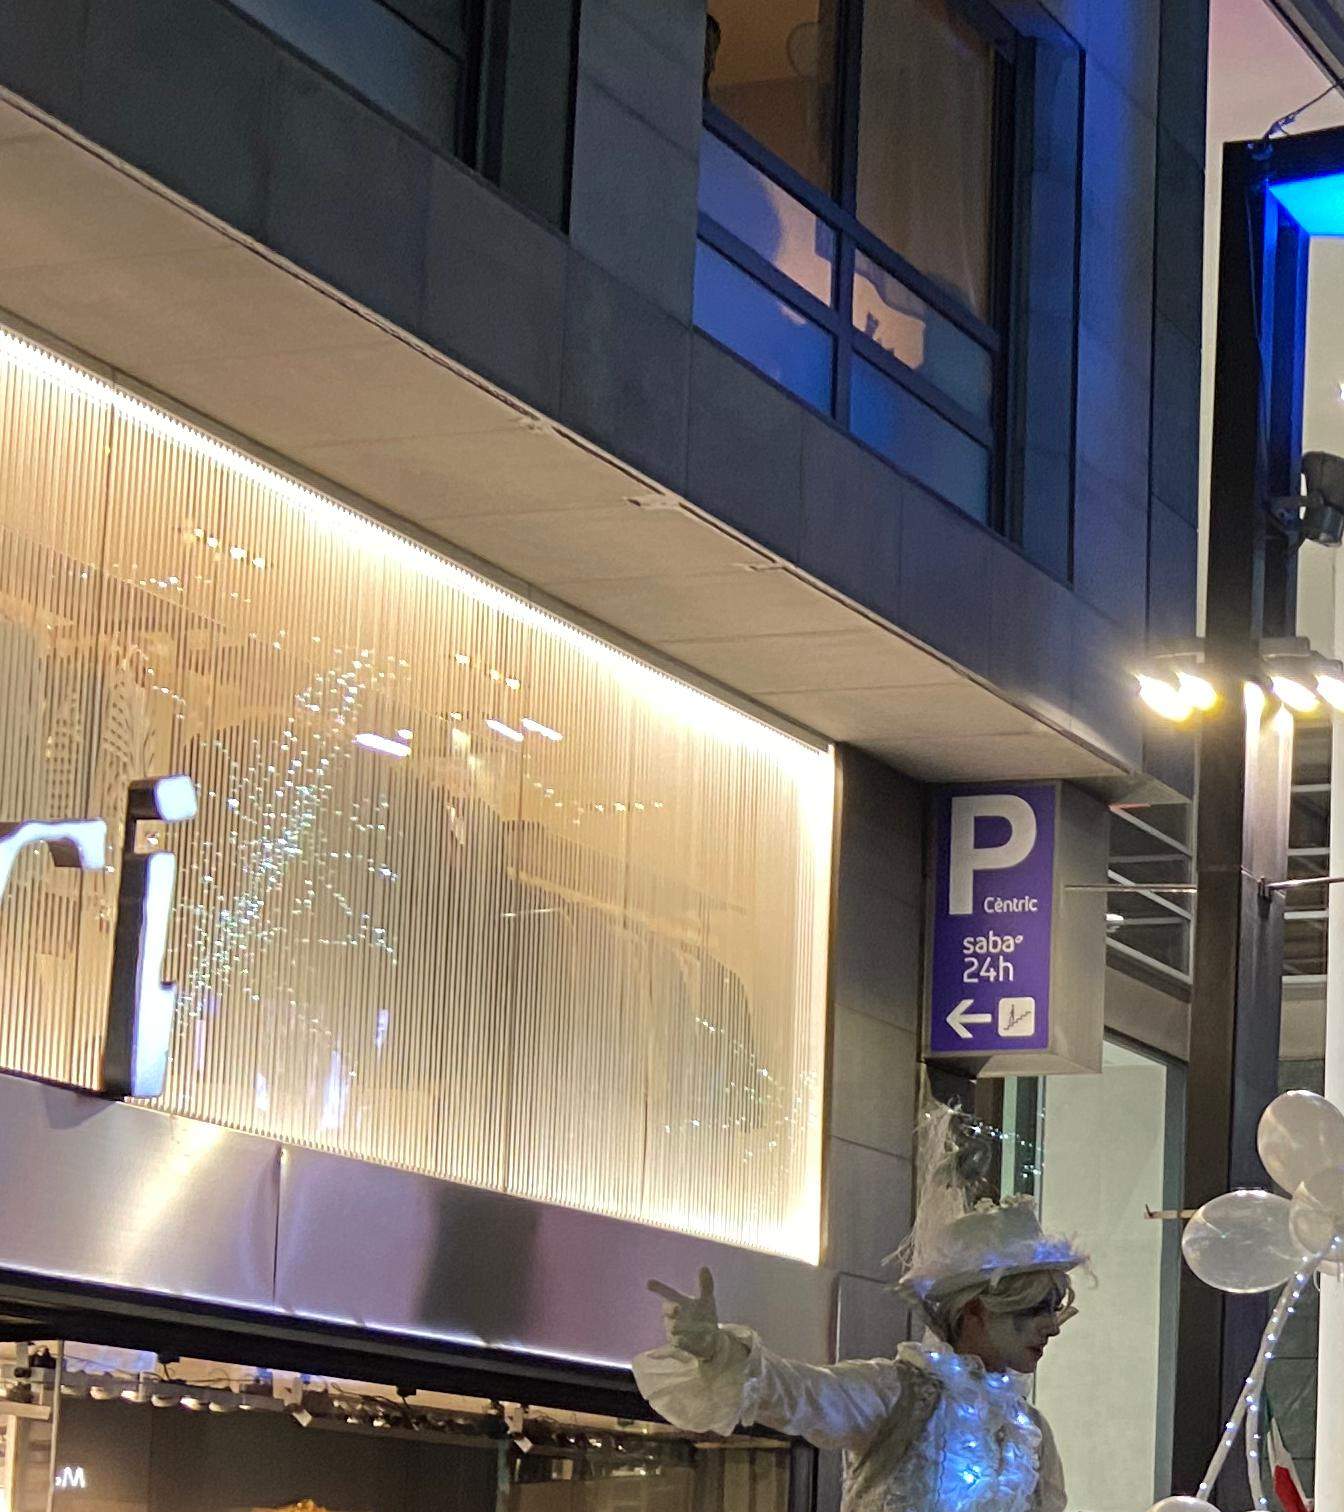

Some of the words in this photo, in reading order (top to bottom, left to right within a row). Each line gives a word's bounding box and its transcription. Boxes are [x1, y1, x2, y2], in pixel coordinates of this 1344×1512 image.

[948, 794, 1037, 915] P
[983, 895, 1038, 914] Cèntric
[962, 955, 1015, 984] 24h
